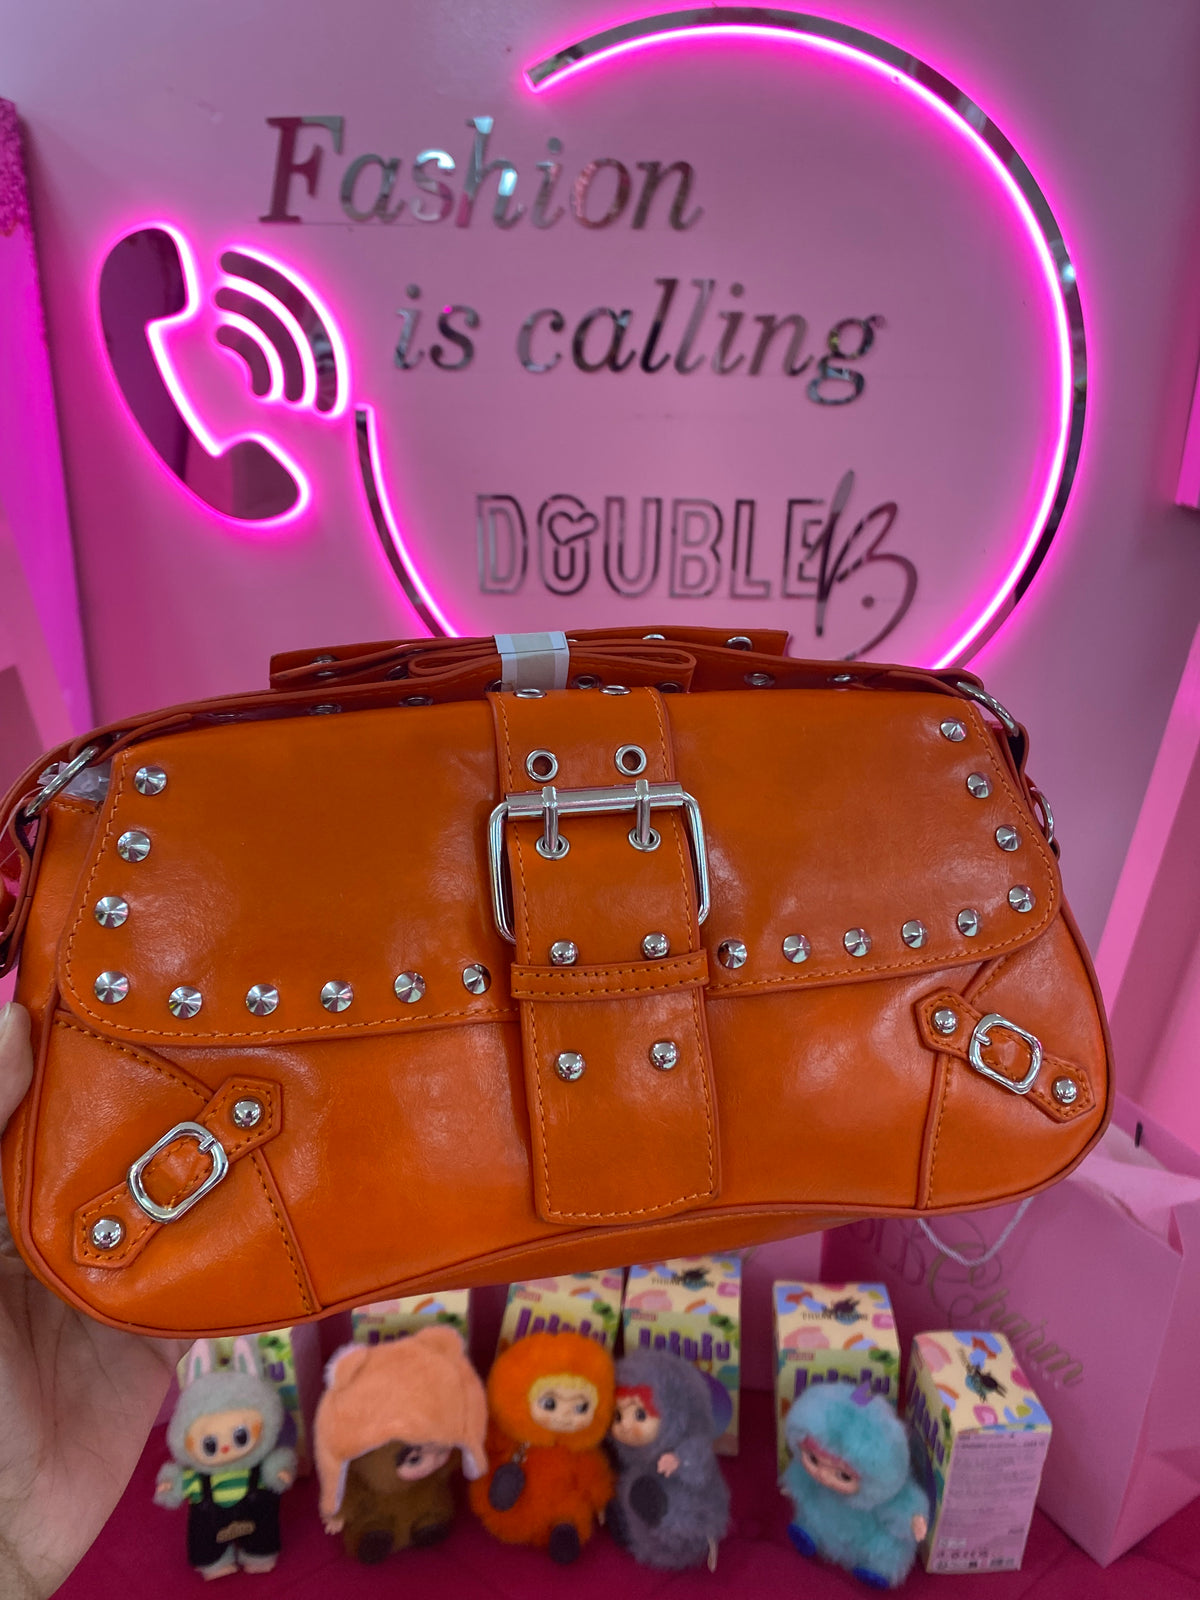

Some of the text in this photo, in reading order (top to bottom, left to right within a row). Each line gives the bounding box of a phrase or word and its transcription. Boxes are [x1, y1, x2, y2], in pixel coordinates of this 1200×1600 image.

[259, 115, 704, 230] Fashion
[393, 278, 885, 406] is calling
